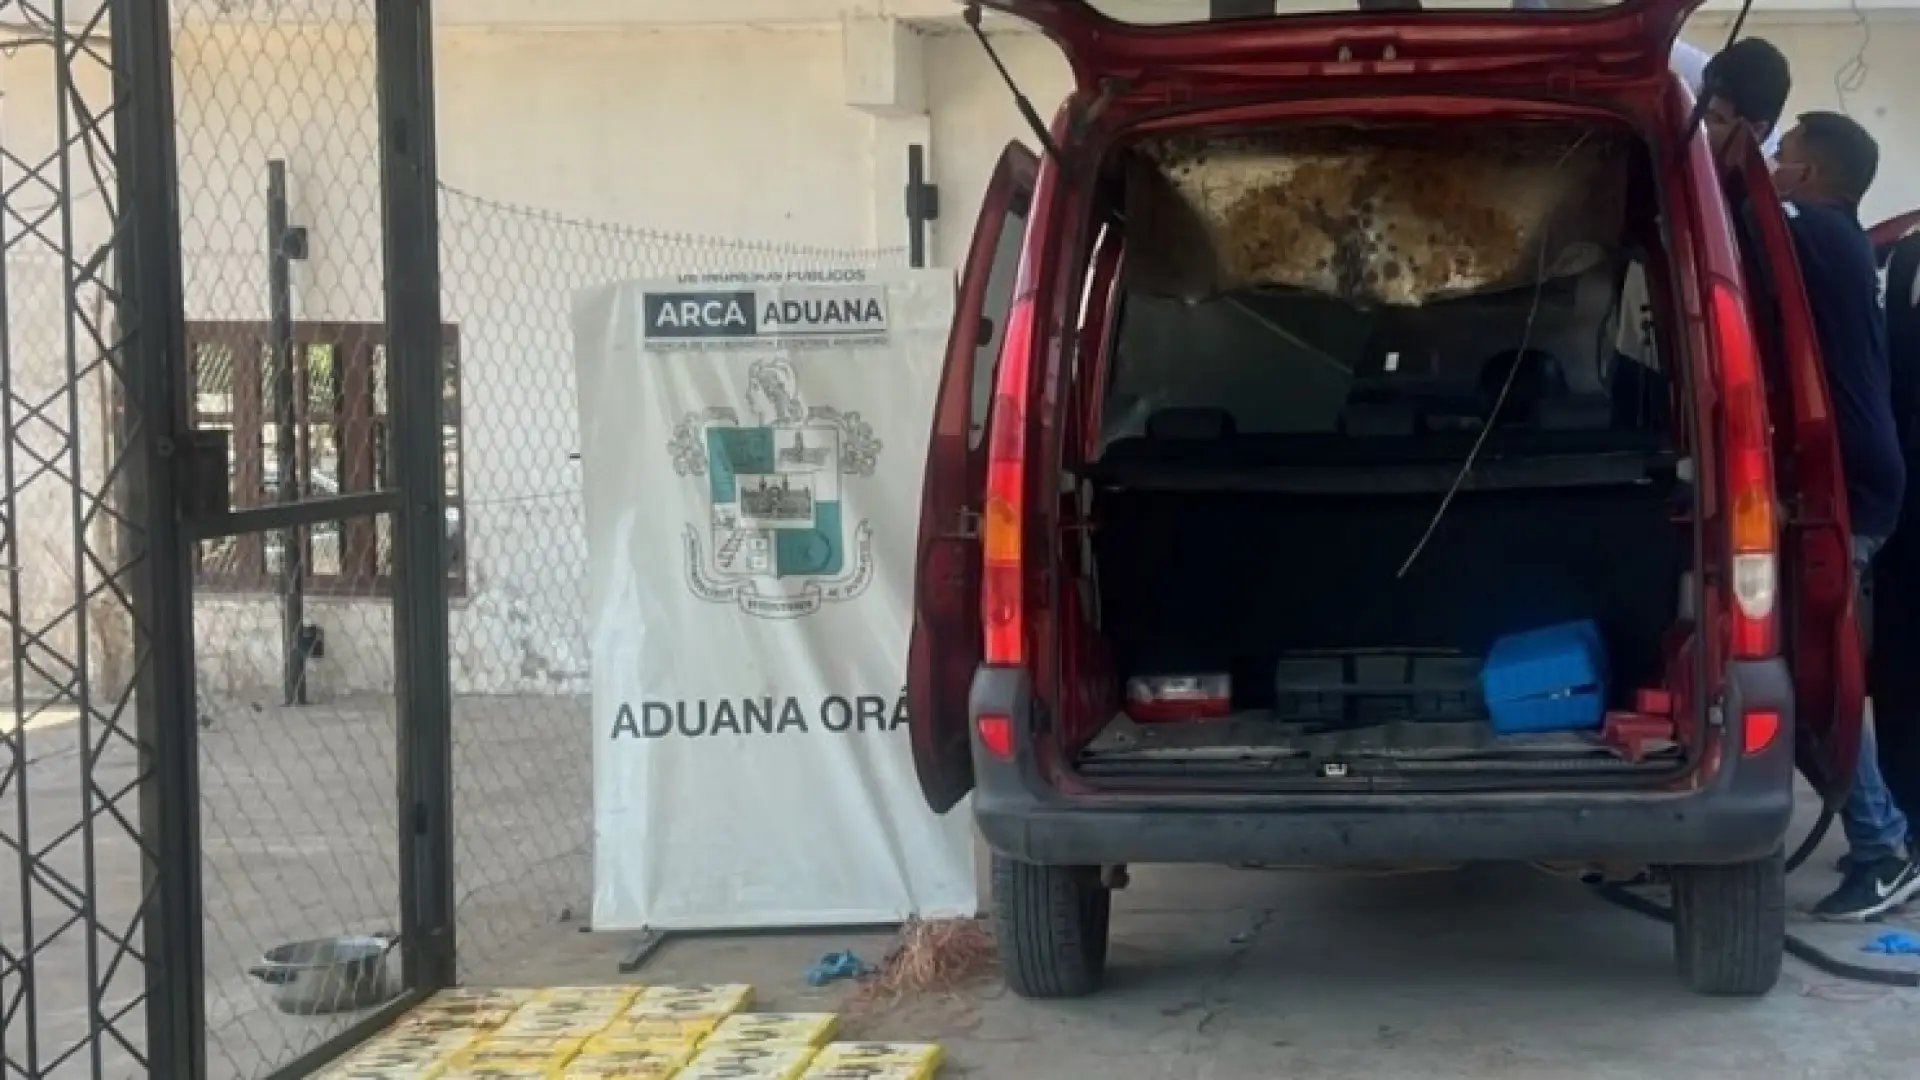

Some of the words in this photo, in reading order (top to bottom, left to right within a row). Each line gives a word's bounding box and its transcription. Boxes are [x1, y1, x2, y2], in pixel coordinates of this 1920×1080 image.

[656, 300, 747, 327] ARCA
[763, 298, 882, 325] ADUANA
[610, 696, 809, 739] ADUANA
